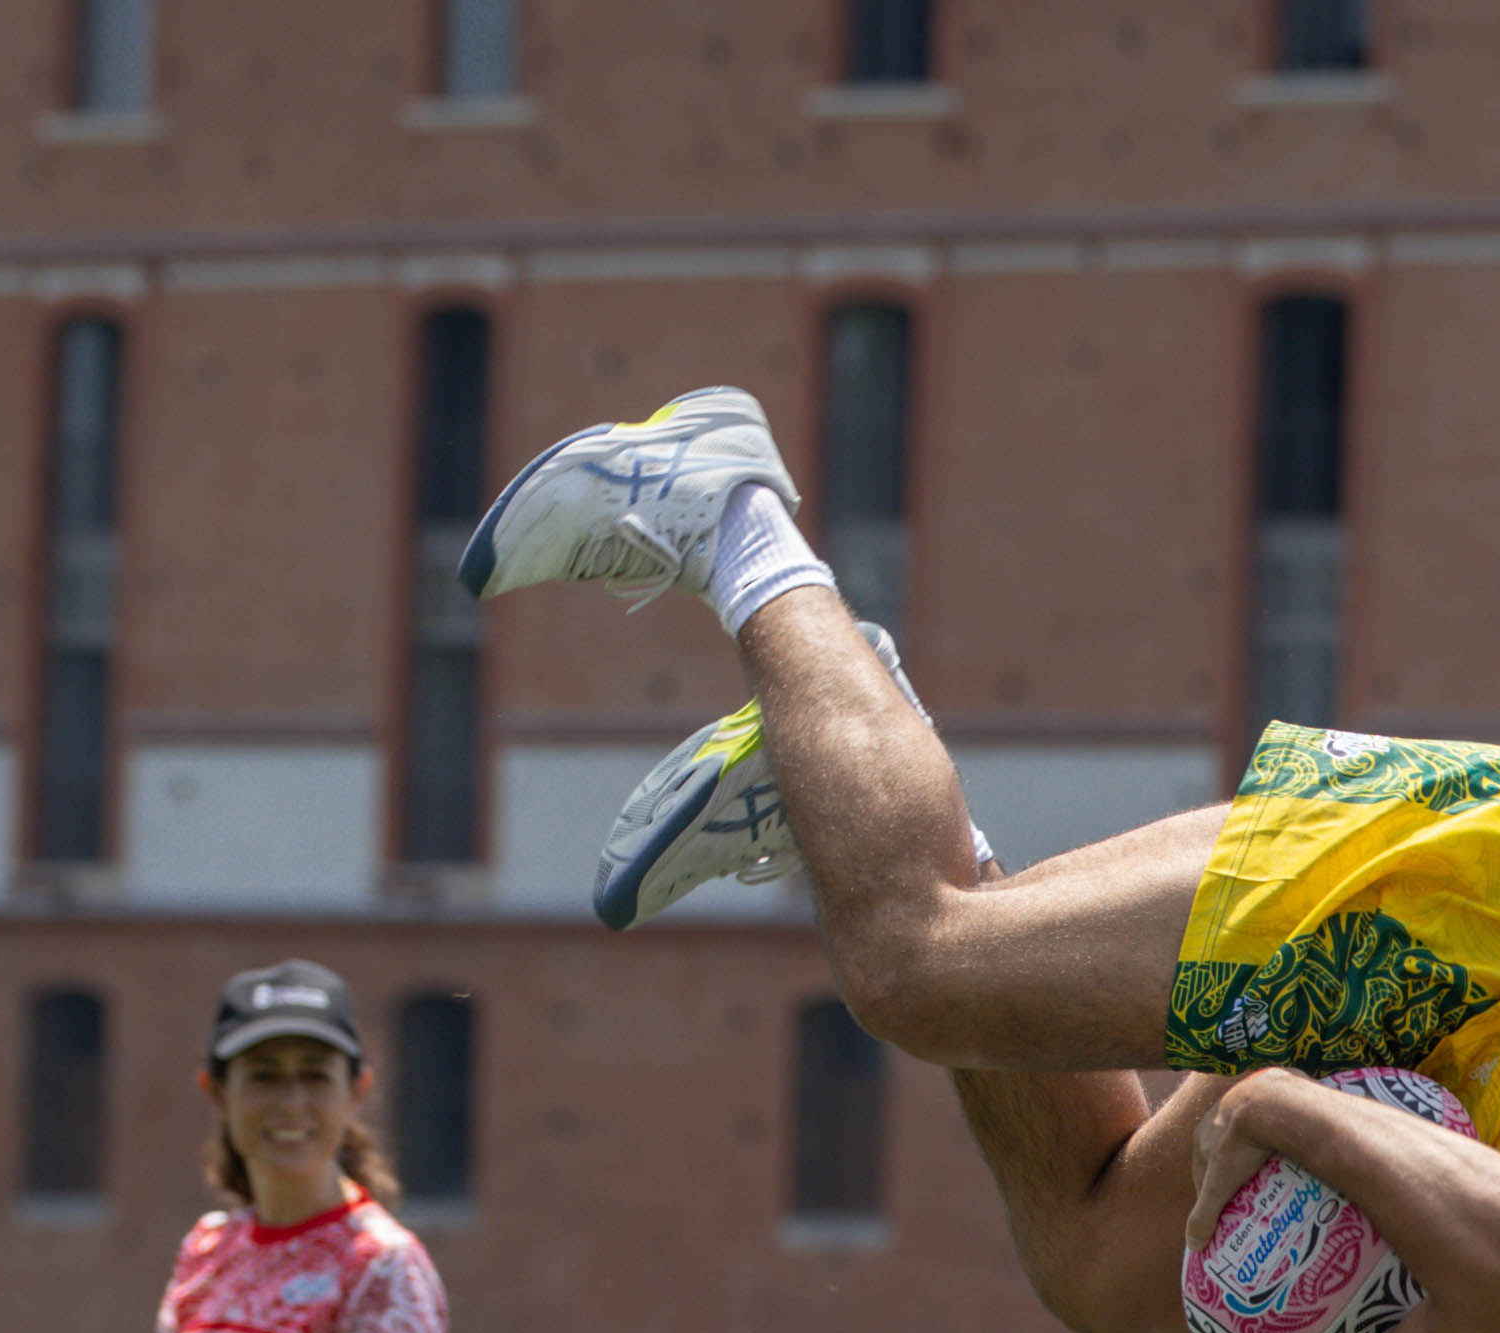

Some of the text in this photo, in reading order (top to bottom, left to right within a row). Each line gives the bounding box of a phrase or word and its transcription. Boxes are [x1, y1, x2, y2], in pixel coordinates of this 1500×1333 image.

[1230, 1180, 1284, 1252] Eden Park
[1237, 1175, 1323, 1284] WateRugby
